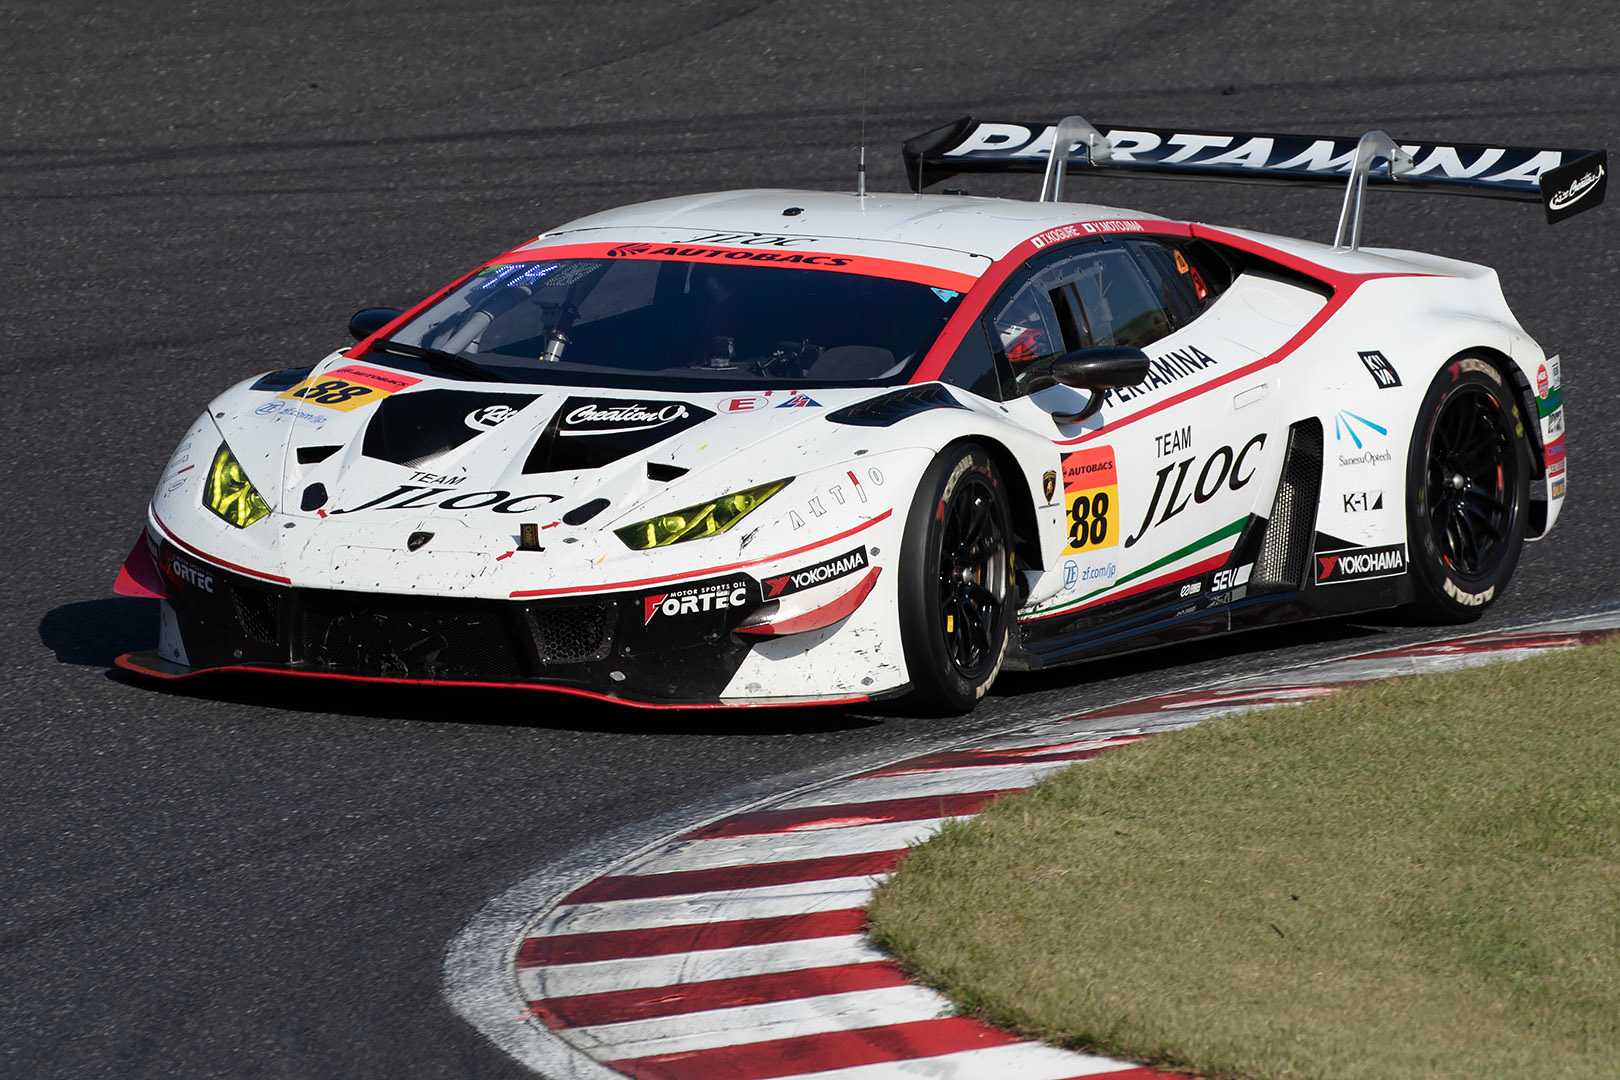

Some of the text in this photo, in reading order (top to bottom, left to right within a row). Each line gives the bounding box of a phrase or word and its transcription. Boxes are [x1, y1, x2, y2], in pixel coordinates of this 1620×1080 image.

[648, 246, 853, 267] AUTOBACS
[352, 368, 410, 387] AUTOBACS
[293, 380, 373, 404] 88
[1155, 425, 1192, 458] TEAM
[409, 471, 467, 485] TEAM
[1068, 461, 1113, 477] AUTOBACS
[329, 484, 565, 515] JLOC
[789, 467, 885, 531] AKTIO
[1124, 433, 1268, 549] JLOC
[1343, 492, 1368, 513] K-1
[1069, 492, 1109, 549] 88
[790, 552, 864, 589] YOKOHAMA
[1082, 562, 1116, 581] zf.com/jp
[1338, 550, 1403, 575] YOKOHAMA
[670, 581, 746, 598] MOTOR SPORTS OIL
